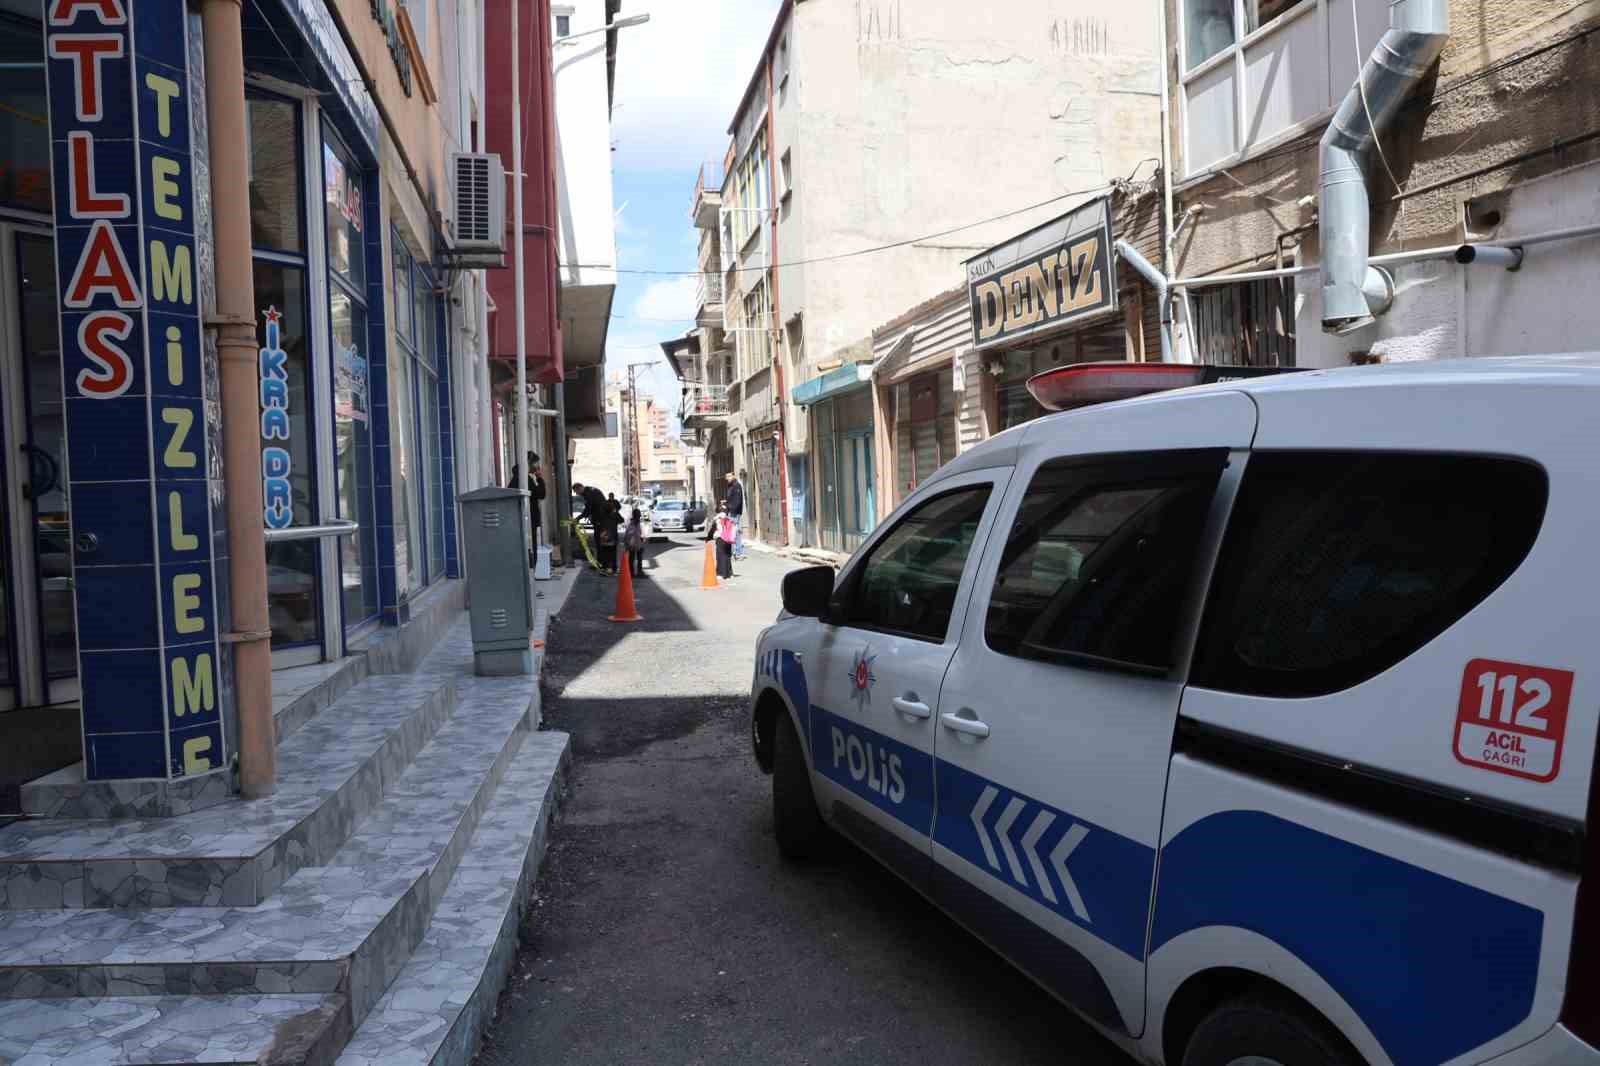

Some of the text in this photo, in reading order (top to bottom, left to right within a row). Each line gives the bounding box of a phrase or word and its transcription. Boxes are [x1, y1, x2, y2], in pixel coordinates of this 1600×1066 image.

[49, 0, 144, 400] TLAS
[970, 255, 997, 281] SALON
[1477, 671, 1552, 731] 112
